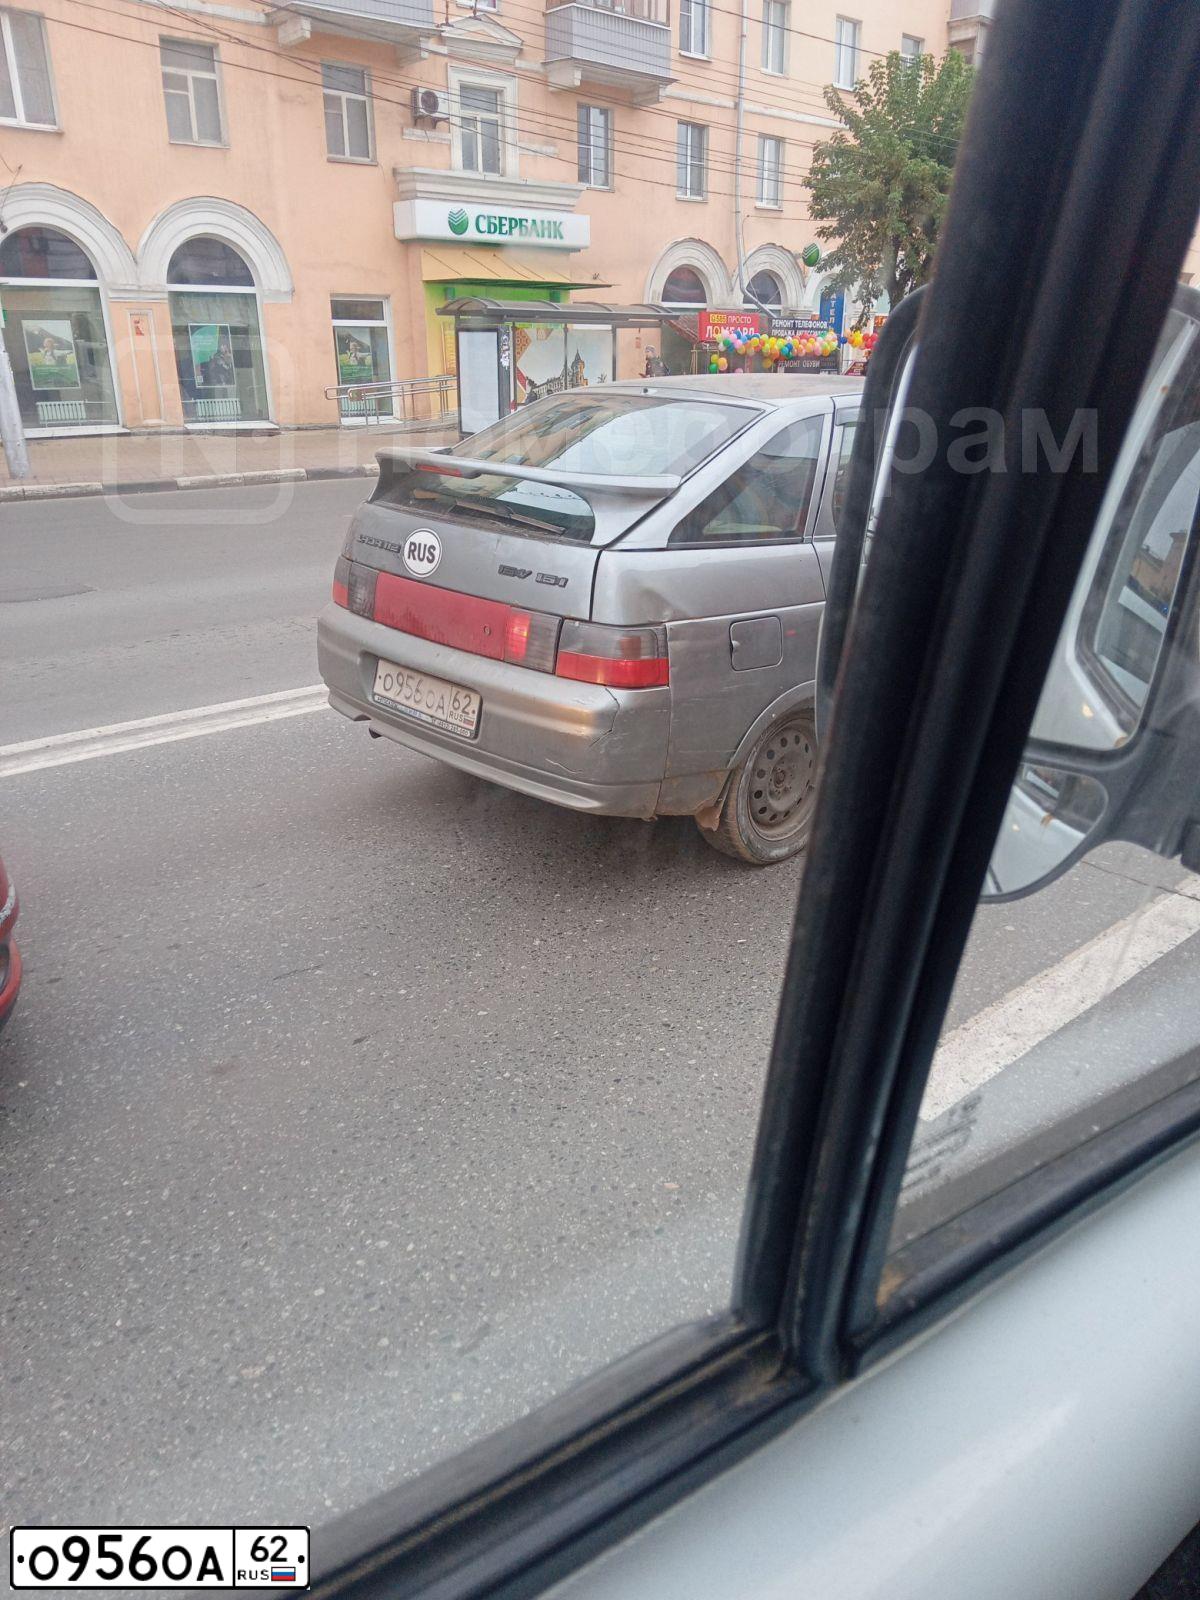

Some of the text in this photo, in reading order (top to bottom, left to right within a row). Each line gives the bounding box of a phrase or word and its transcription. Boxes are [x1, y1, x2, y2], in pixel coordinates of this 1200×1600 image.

[475, 214, 564, 240] СБЕРБАНК
[728, 315, 752, 324] ПРОСТО
[772, 319, 829, 329] РЕМОНТ ТЕЛЕФОНОВ
[407, 541, 436, 564] RUS
[452, 690, 472, 716] 62
[448, 710, 464, 722] RUS
